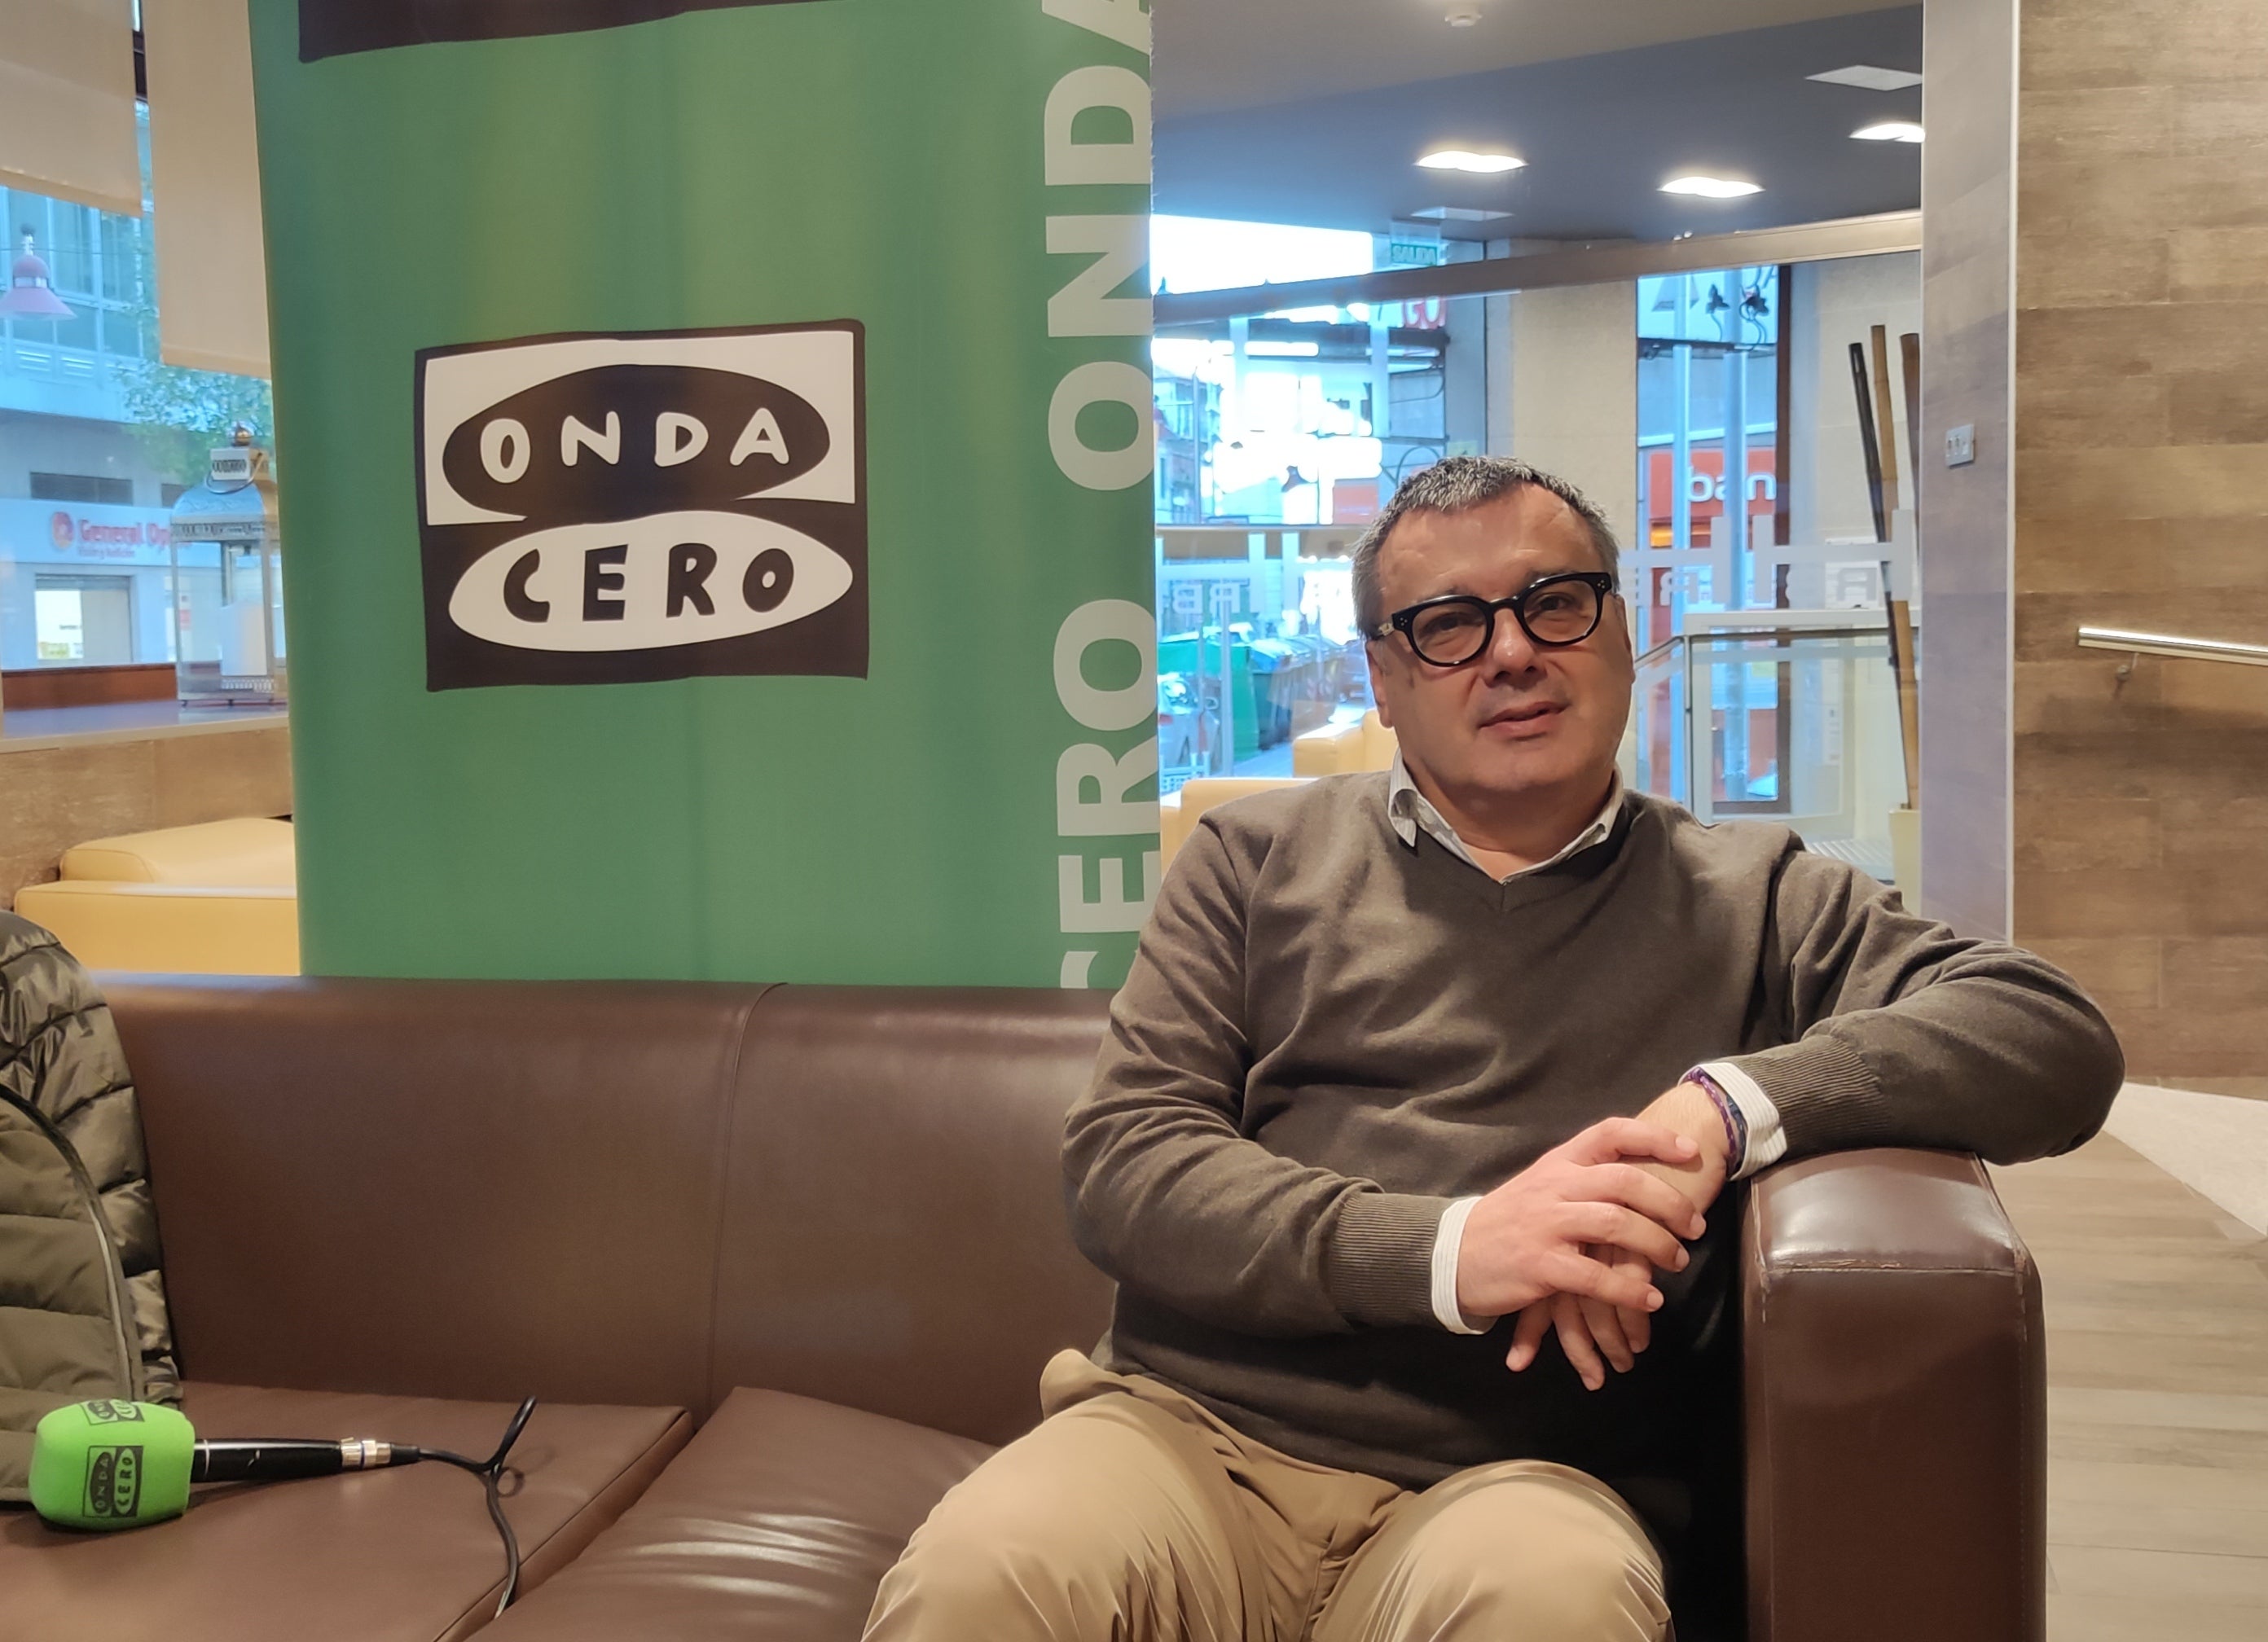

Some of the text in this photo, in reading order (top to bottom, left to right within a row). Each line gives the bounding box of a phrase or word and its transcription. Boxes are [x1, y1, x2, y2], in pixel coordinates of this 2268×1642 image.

[1391, 245, 1437, 265] SALIDA
[479, 406, 789, 483] ONDA
[79, 519, 143, 543] General
[503, 542, 795, 623] CERO
[94, 1457, 108, 1506] ONDA
[116, 1456, 133, 1506] CERO
